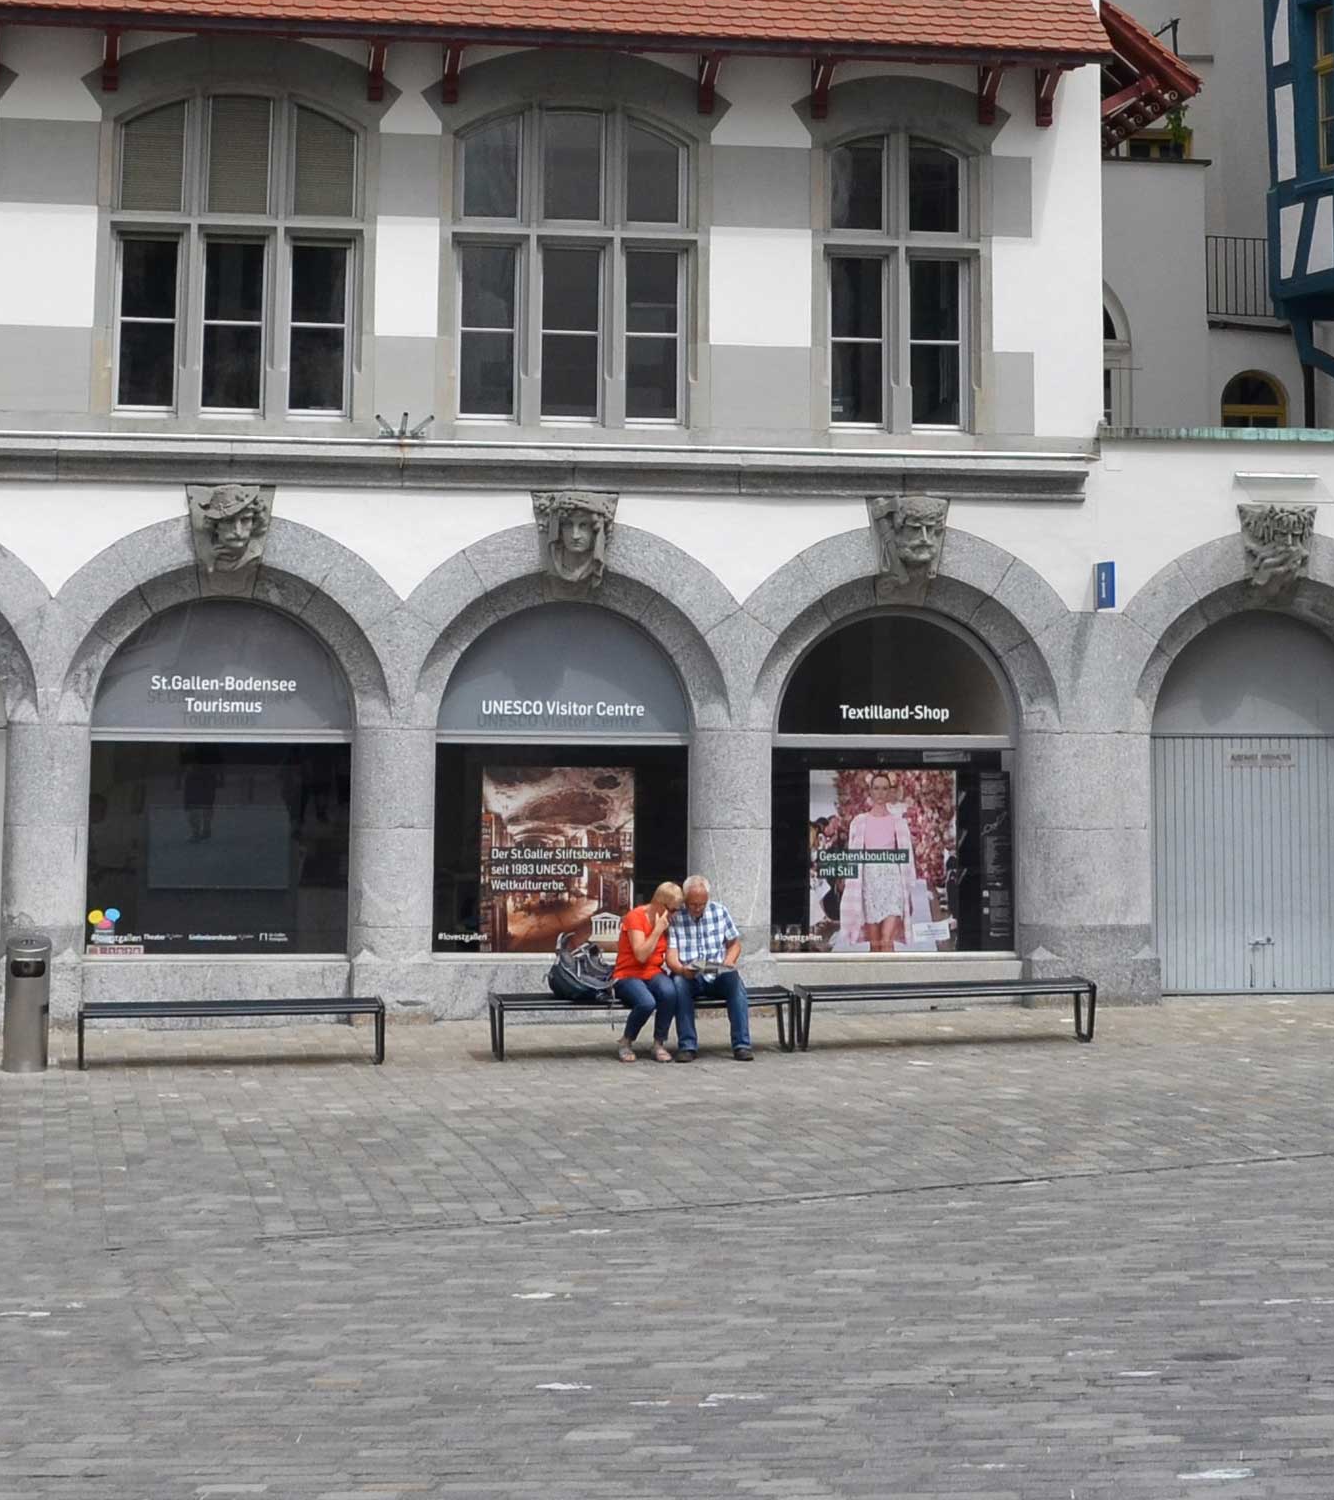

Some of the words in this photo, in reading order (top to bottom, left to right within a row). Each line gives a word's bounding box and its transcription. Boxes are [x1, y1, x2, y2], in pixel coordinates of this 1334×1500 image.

[151, 675, 297, 692] St.Gallen-Bodensee
[185, 697, 263, 713] Tourismus
[482, 700, 543, 715] UNESCO
[546, 701, 593, 716] Visitor
[596, 702, 645, 716] Centre
[839, 704, 950, 722] Textilland-Shop
[492, 849, 508, 859] Der
[510, 849, 553, 859] St.Galler
[555, 848, 611, 860] Stiftsbezirk
[820, 851, 906, 863] Geschenkboutique
[492, 864, 509, 874] seit
[512, 864, 534, 874] 1983
[536, 864, 581, 875] UNESCO-
[820, 867, 835, 877] mit
[838, 866, 854, 877] Stil
[491, 879, 567, 891] Weltkulturerbe.
